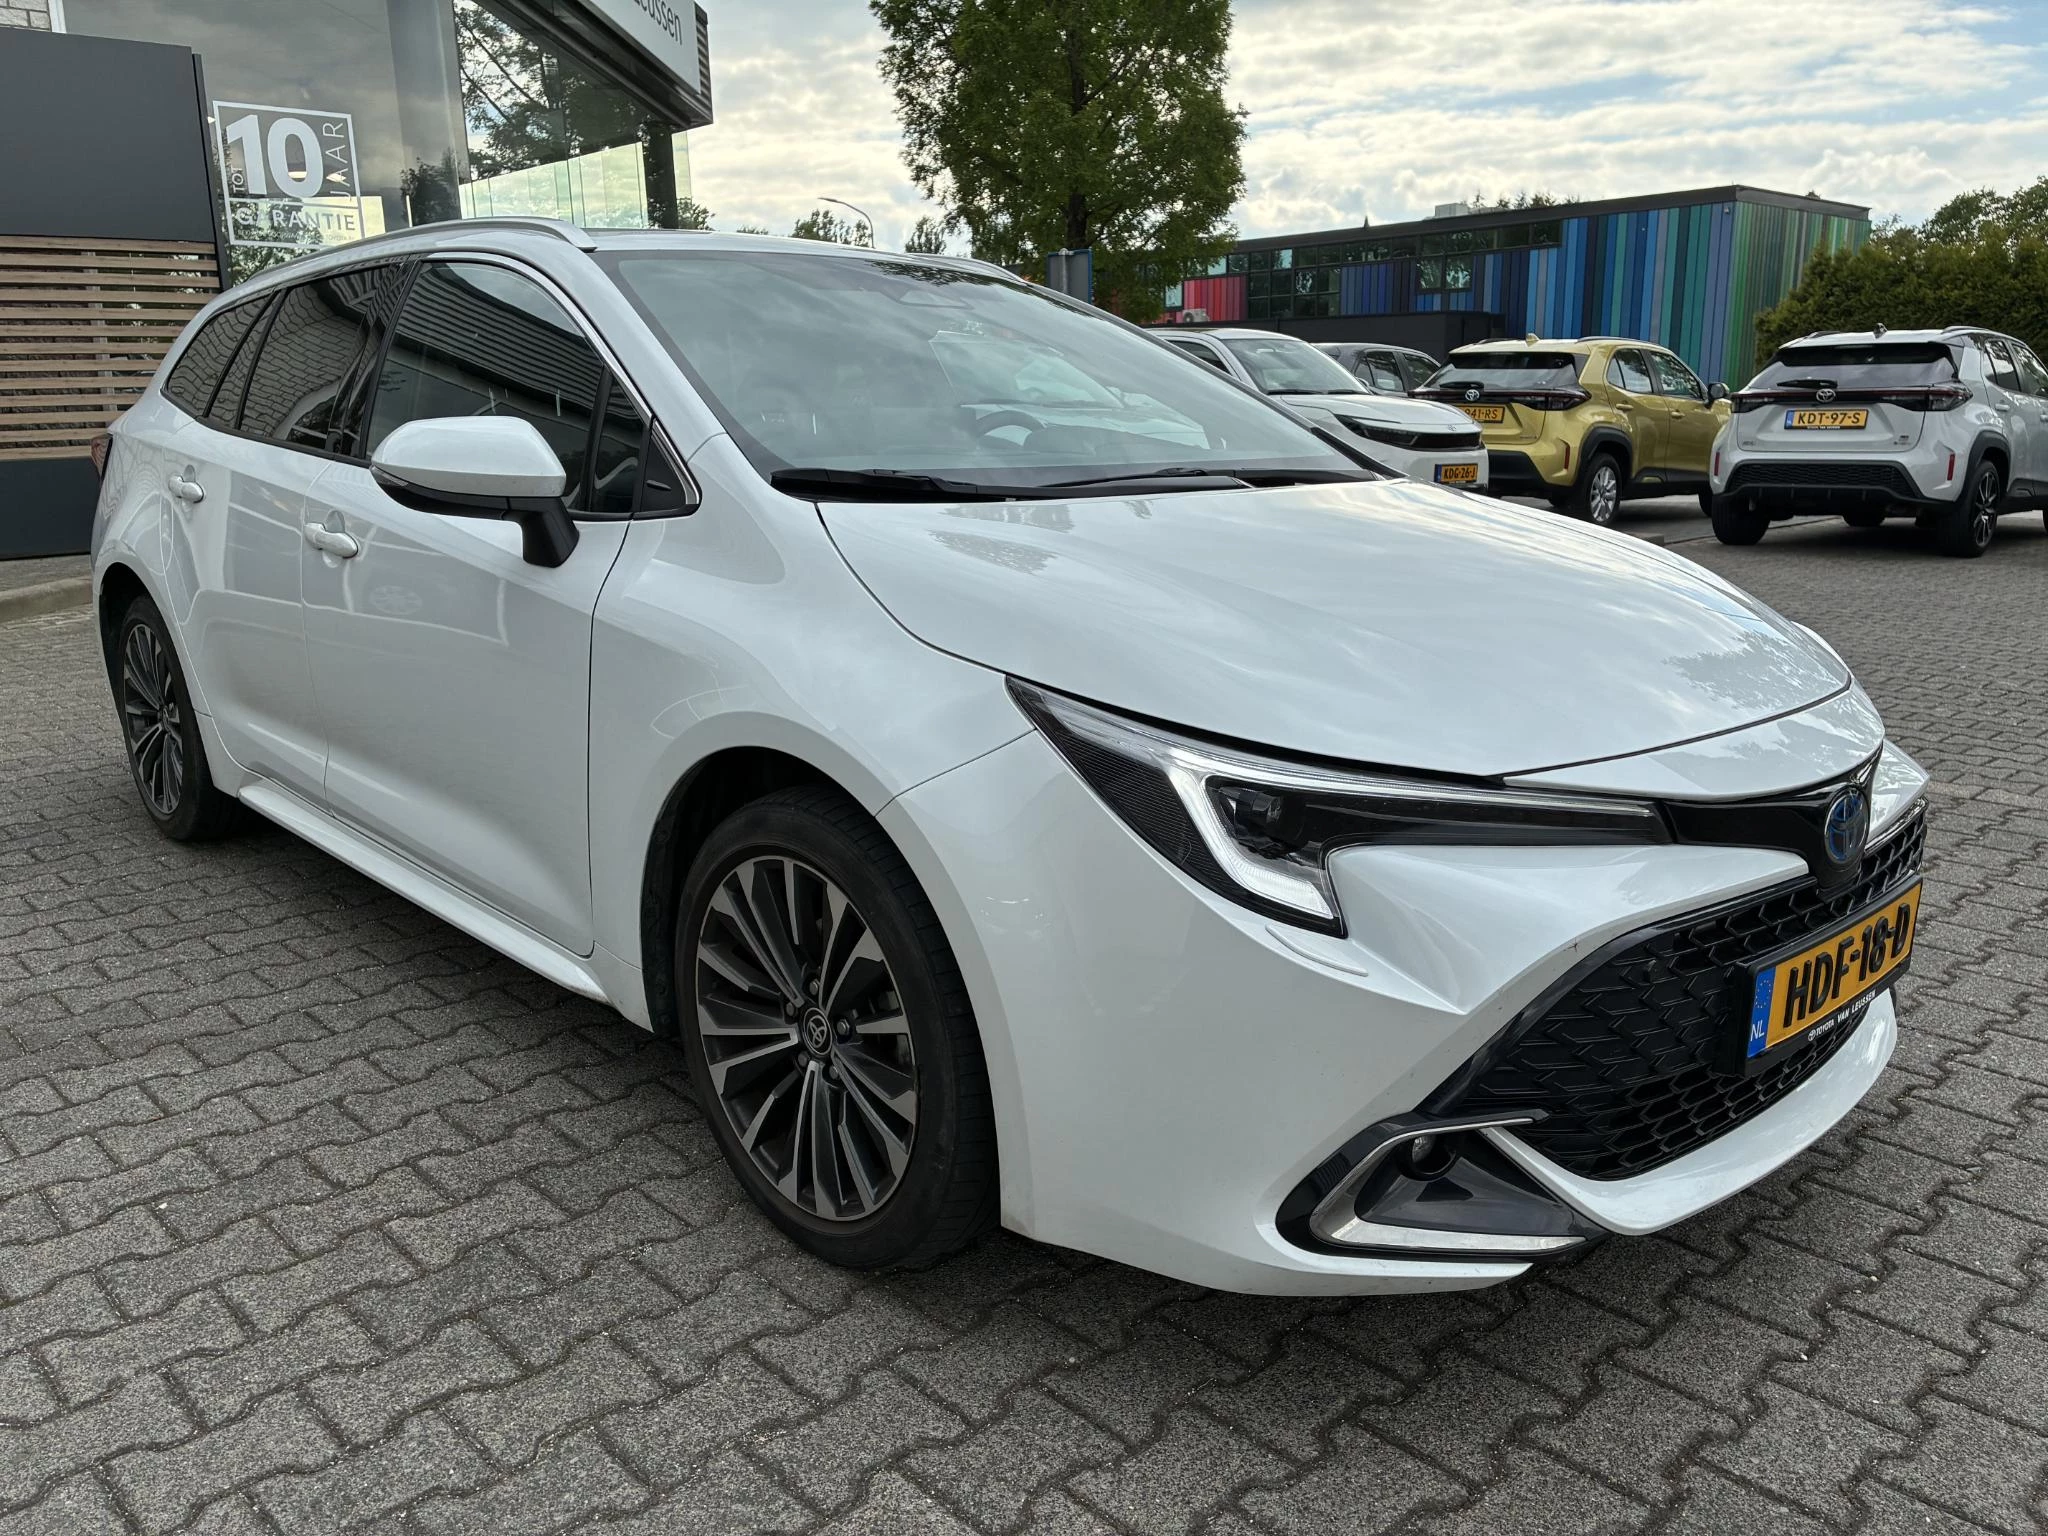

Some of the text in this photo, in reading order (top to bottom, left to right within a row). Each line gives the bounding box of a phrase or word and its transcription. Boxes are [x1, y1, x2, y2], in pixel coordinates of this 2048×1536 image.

[634, 0, 683, 46] ussen
[226, 114, 324, 199] 10
[322, 122, 352, 201] JAAR
[1464, 408, 1498, 419] 941-RS
[1797, 411, 1861, 425] KDT-97-S
[1443, 467, 1476, 480] KDG-26-J
[1783, 903, 1911, 1028] HDF-18-D
[1750, 1020, 1765, 1042] NL
[1816, 990, 1876, 1036] TOYOTA VAN LEUSSEN
